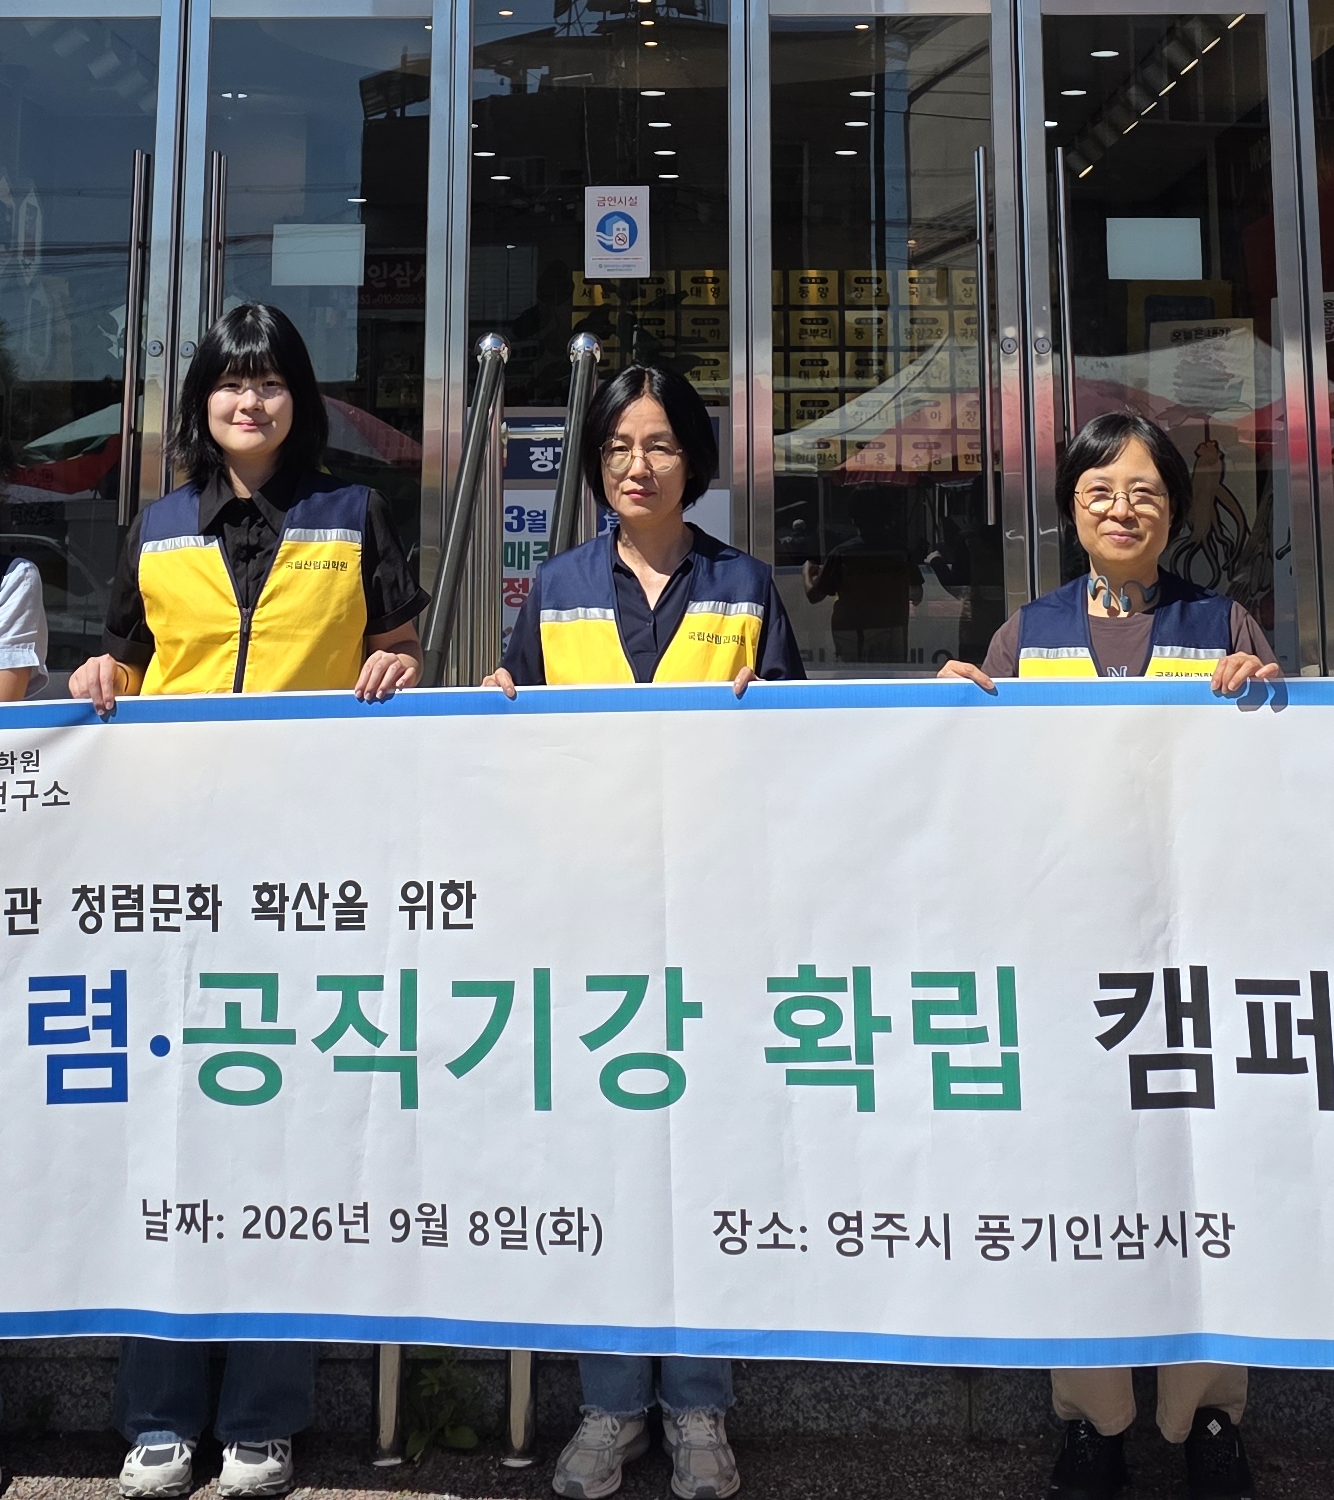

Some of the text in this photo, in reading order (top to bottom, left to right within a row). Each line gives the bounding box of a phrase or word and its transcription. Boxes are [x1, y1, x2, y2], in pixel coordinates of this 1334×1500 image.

[596, 195, 638, 207] 금연시설
[504, 505, 547, 533] 3월
[71, 882, 223, 934] 청렴문화
[250, 879, 369, 933] 확산을
[398, 879, 477, 931] 위한
[763, 964, 1023, 1112] 확립
[140, 1199, 1236, 1262] 날짜: 2026년 9월 8일(화) 장소: 영주시 풍기인삼시장
